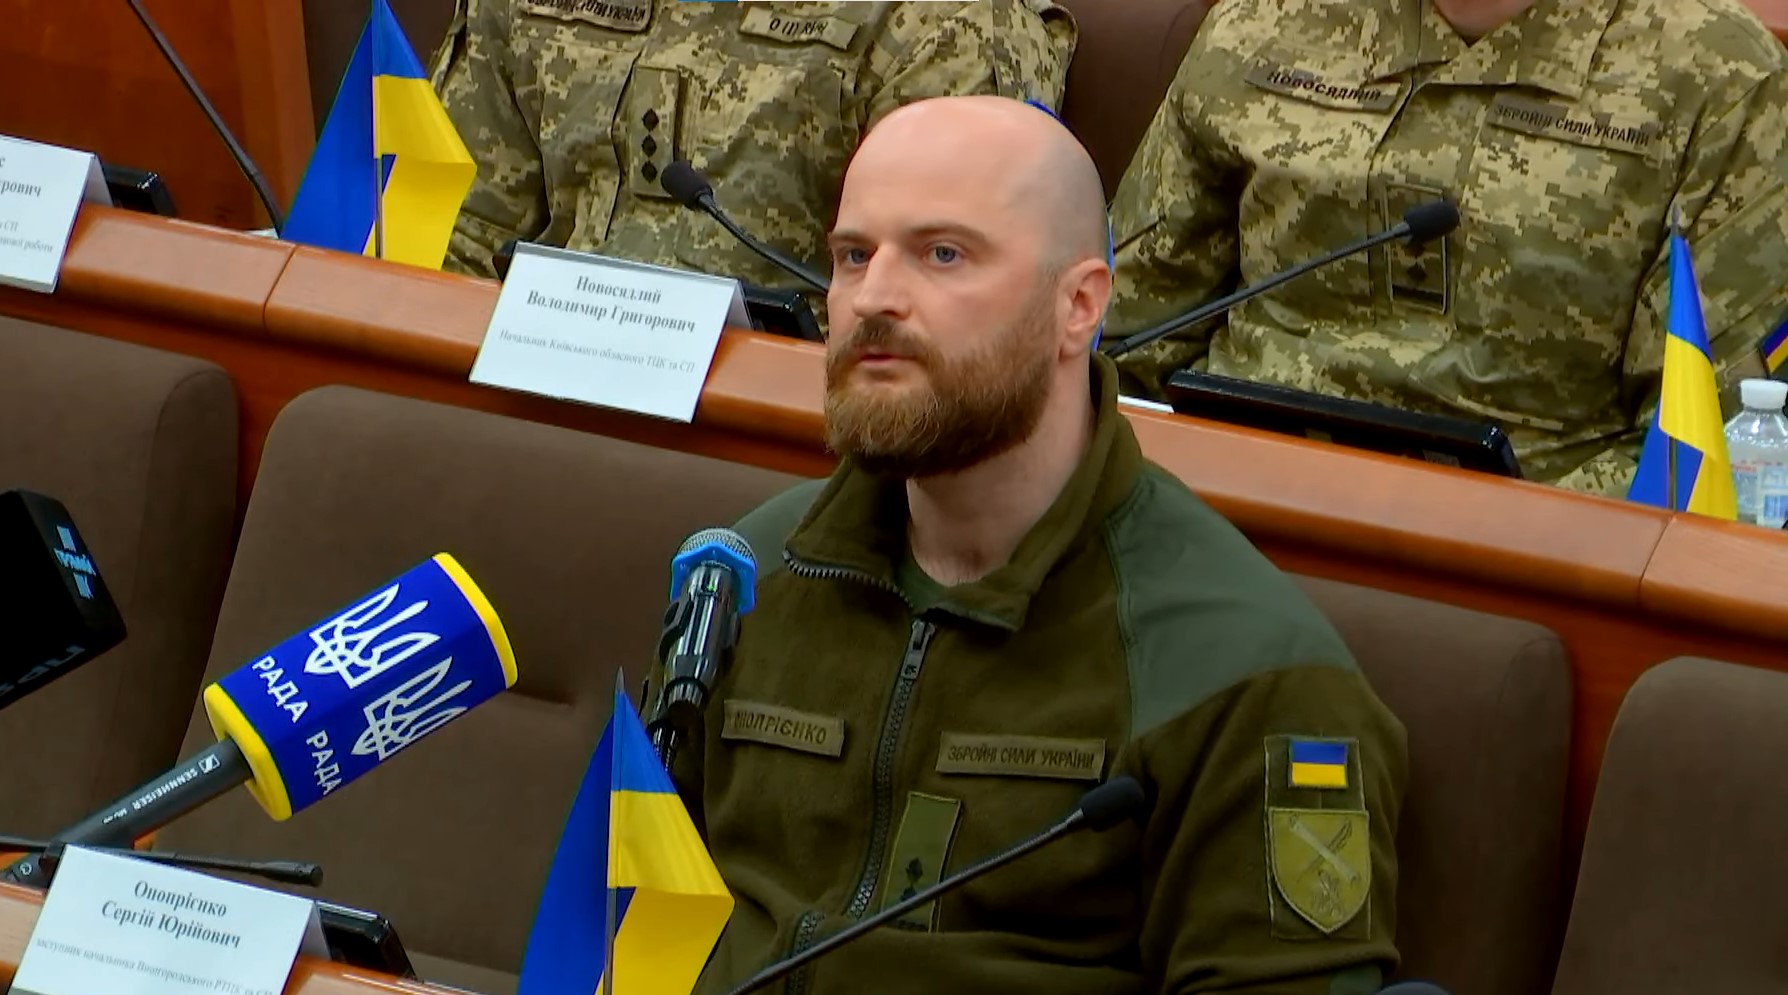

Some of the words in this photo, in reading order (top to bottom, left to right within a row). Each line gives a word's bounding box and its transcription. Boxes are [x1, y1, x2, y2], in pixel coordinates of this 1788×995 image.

[1554, 117, 1594, 139] СИЛИ
[527, 290, 607, 321] Володимир
[610, 305, 697, 334] Григорович
[251, 655, 310, 723] РАДА
[306, 730, 342, 796] РАДА
[946, 747, 998, 764] ЗБРОЙНІ
[1000, 749, 1037, 766] СИЛИ
[1040, 749, 1095, 770] УКРАЇНИ
[132, 767, 199, 811] SENNHEISER
[134, 879, 228, 918] Онопрієнко
[101, 900, 154, 930] Сергій
[157, 911, 242, 949] Юрійович
